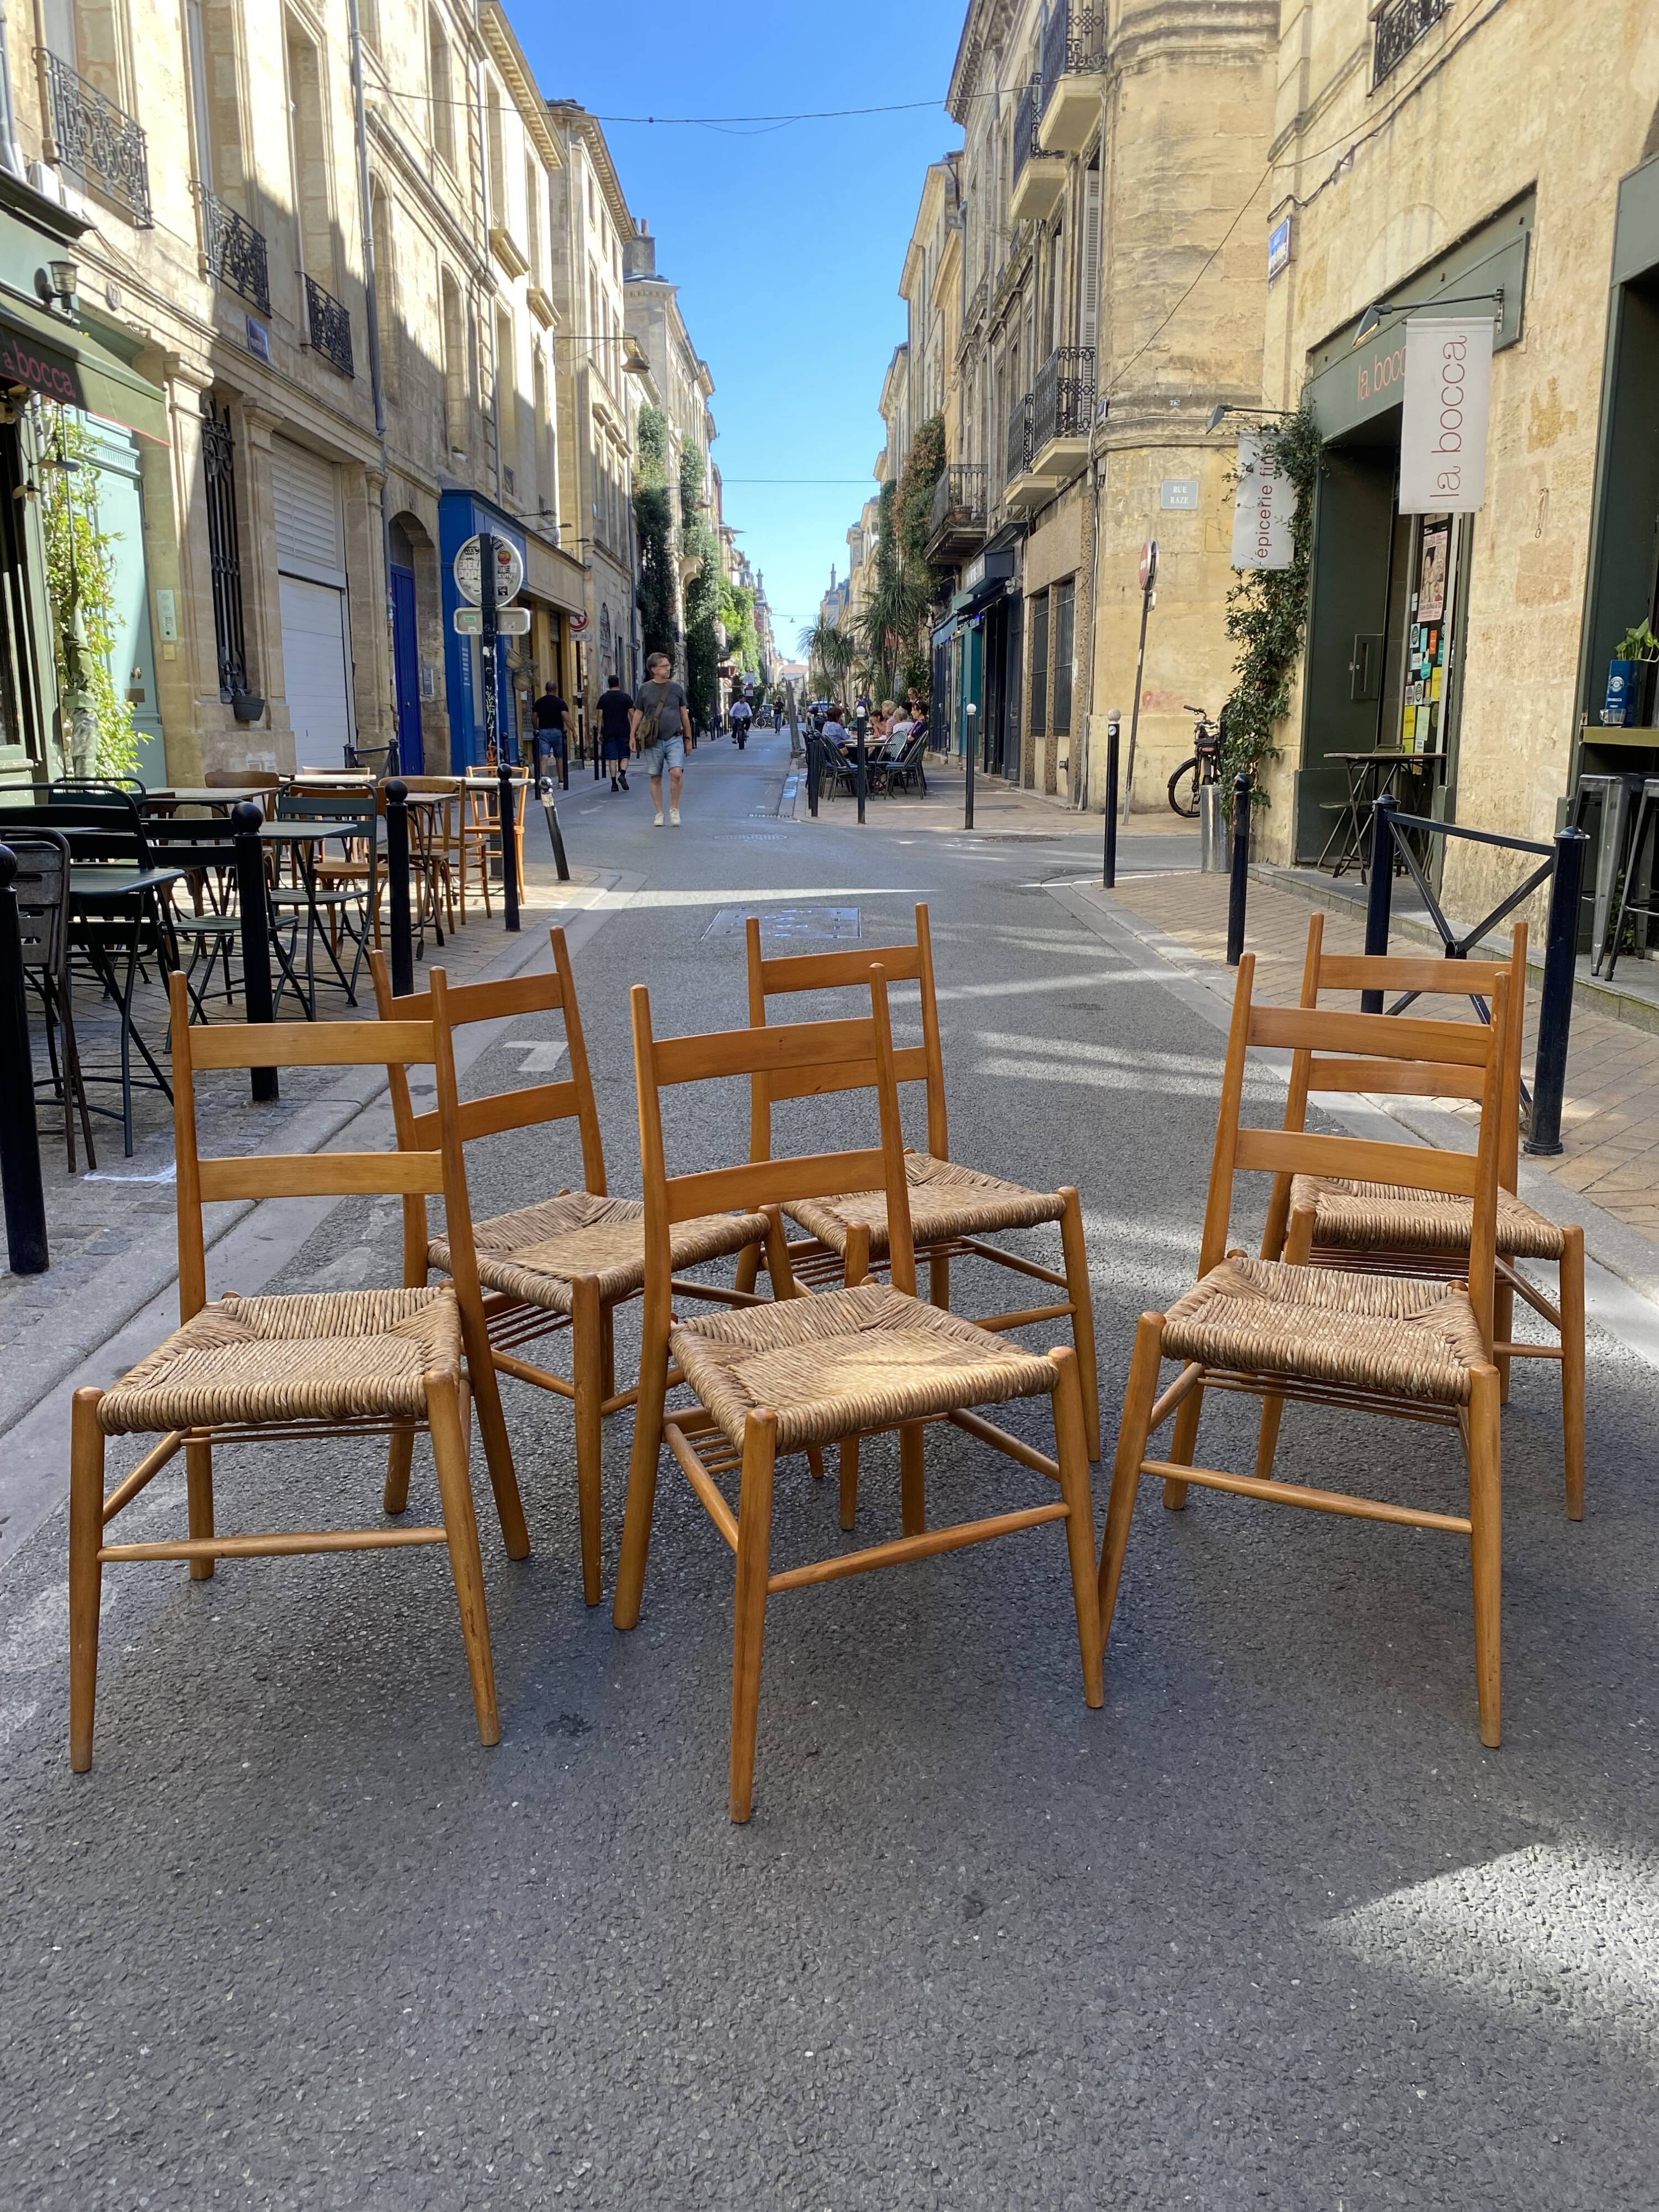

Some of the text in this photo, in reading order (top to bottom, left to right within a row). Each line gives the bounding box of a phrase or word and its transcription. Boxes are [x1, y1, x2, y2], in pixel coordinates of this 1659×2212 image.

[12, 339, 76, 398] bocca
[1358, 345, 1406, 401] la bocc
[1430, 335, 1467, 497] la bocca
[1255, 485, 1272, 558] épicerie
